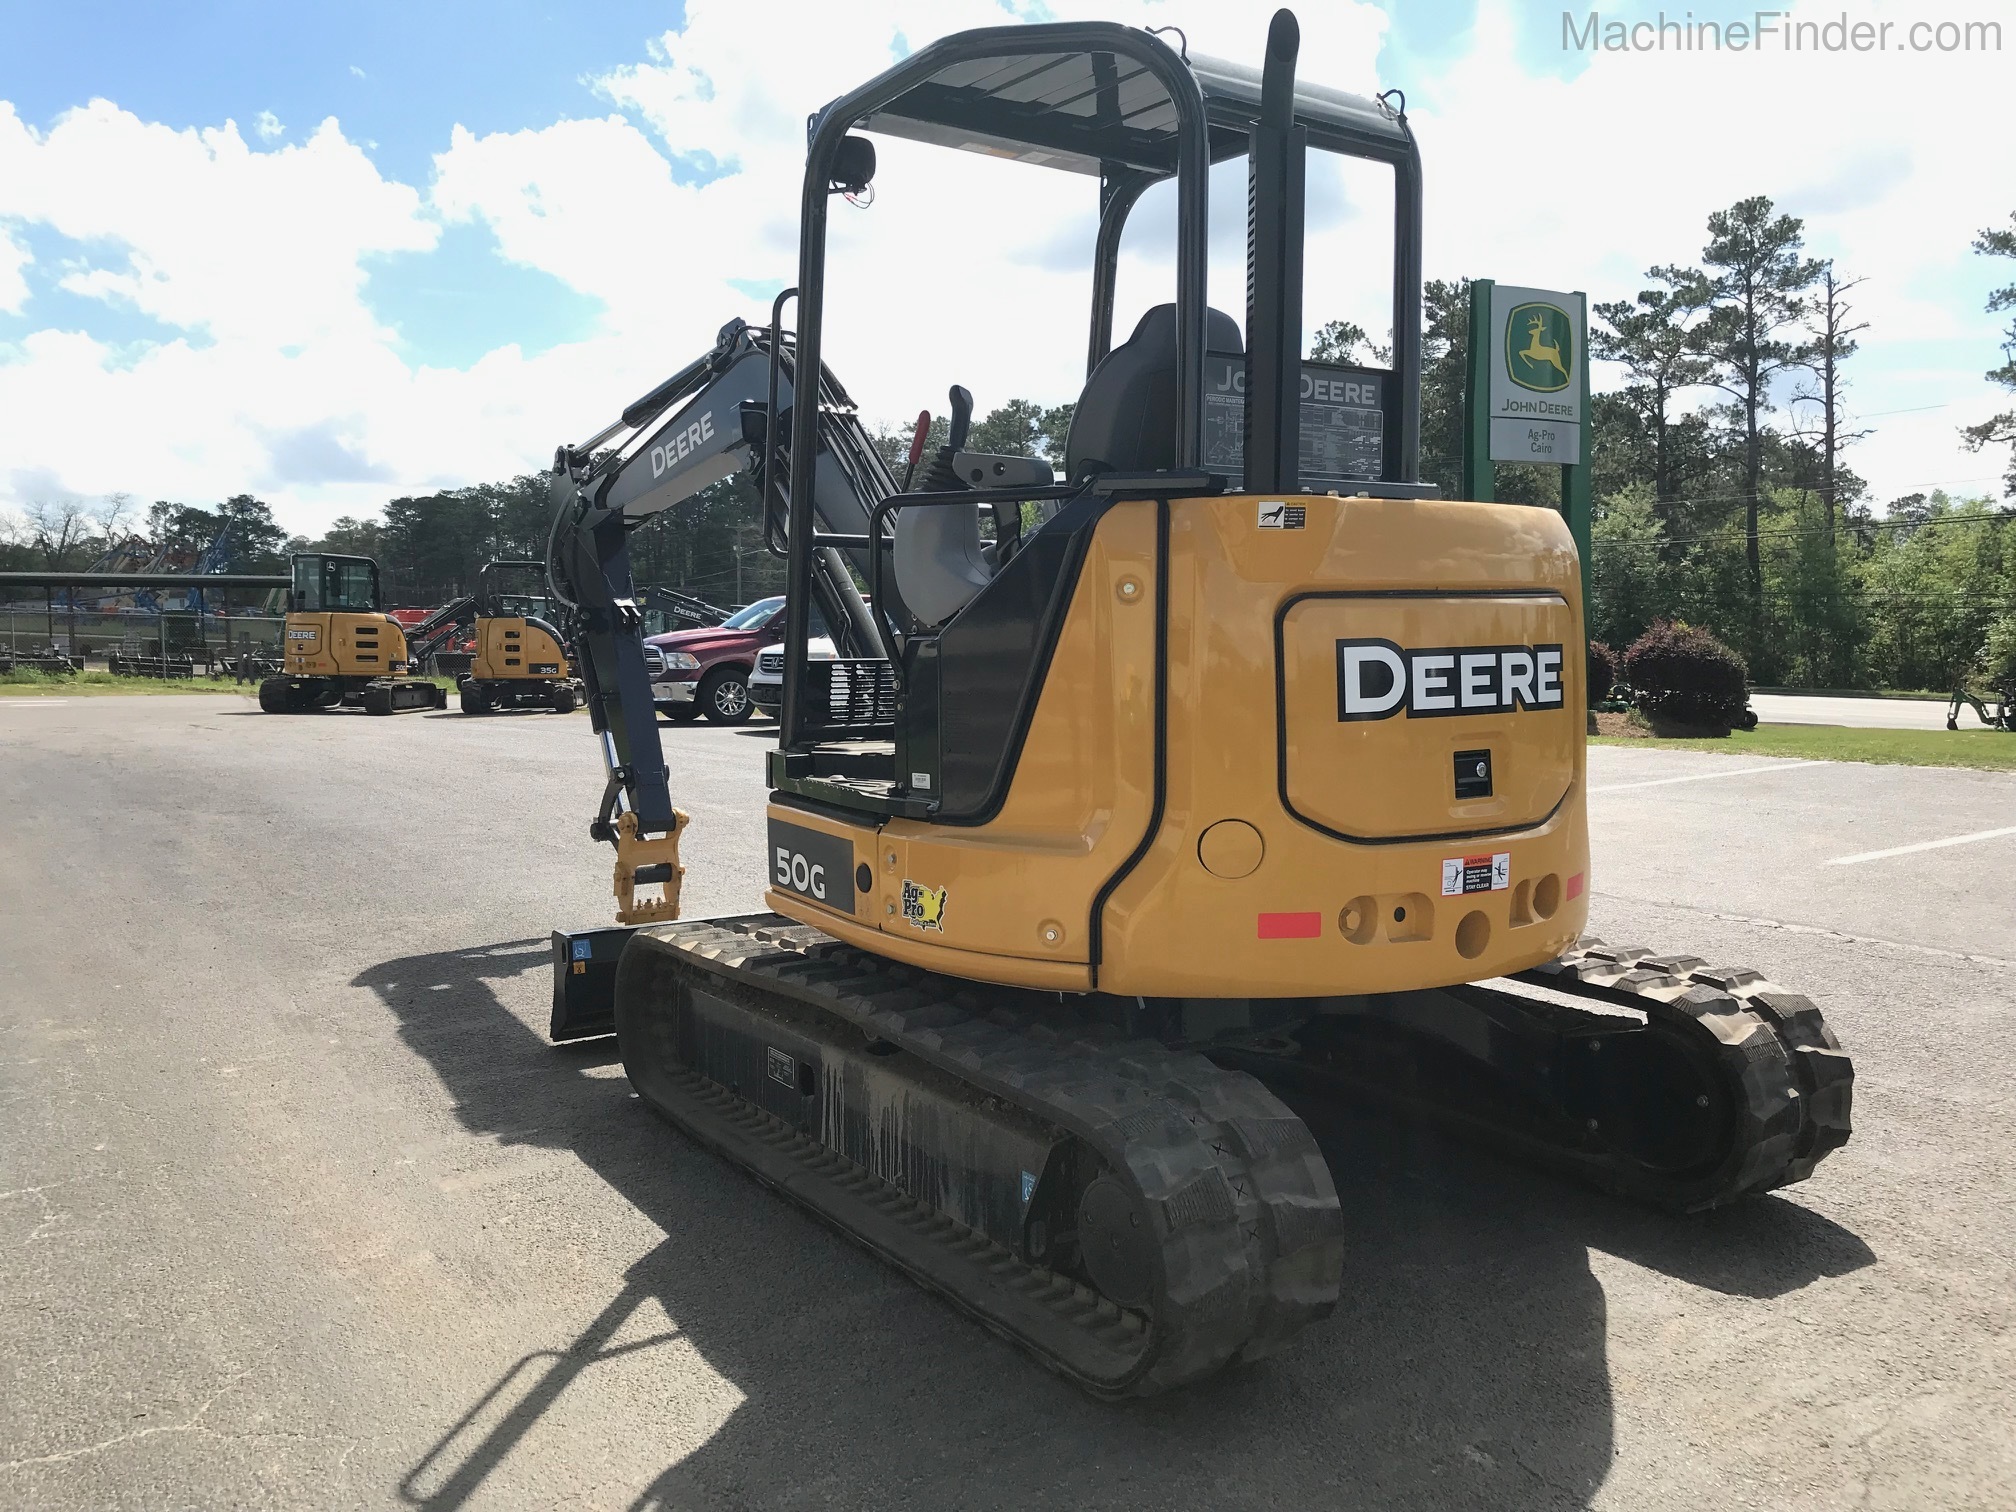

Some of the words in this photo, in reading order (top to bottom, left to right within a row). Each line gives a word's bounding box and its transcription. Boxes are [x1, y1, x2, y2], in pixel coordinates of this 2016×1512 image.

[1217, 365, 1245, 393] JO
[1502, 399, 1537, 413] JOHN
[1539, 401, 1573, 416] DEERE
[1528, 428, 1555, 442] Ag-Pro
[651, 410, 715, 479] DEERE
[1531, 442, 1552, 454] Cairo
[674, 605, 702, 620] DEERE
[288, 630, 316, 640] DEERE
[540, 666, 557, 674] 35G
[1341, 643, 1562, 716] DEERE
[776, 846, 826, 899] 50G
[902, 881, 923, 903] Ag-
[903, 898, 924, 917] Pro
